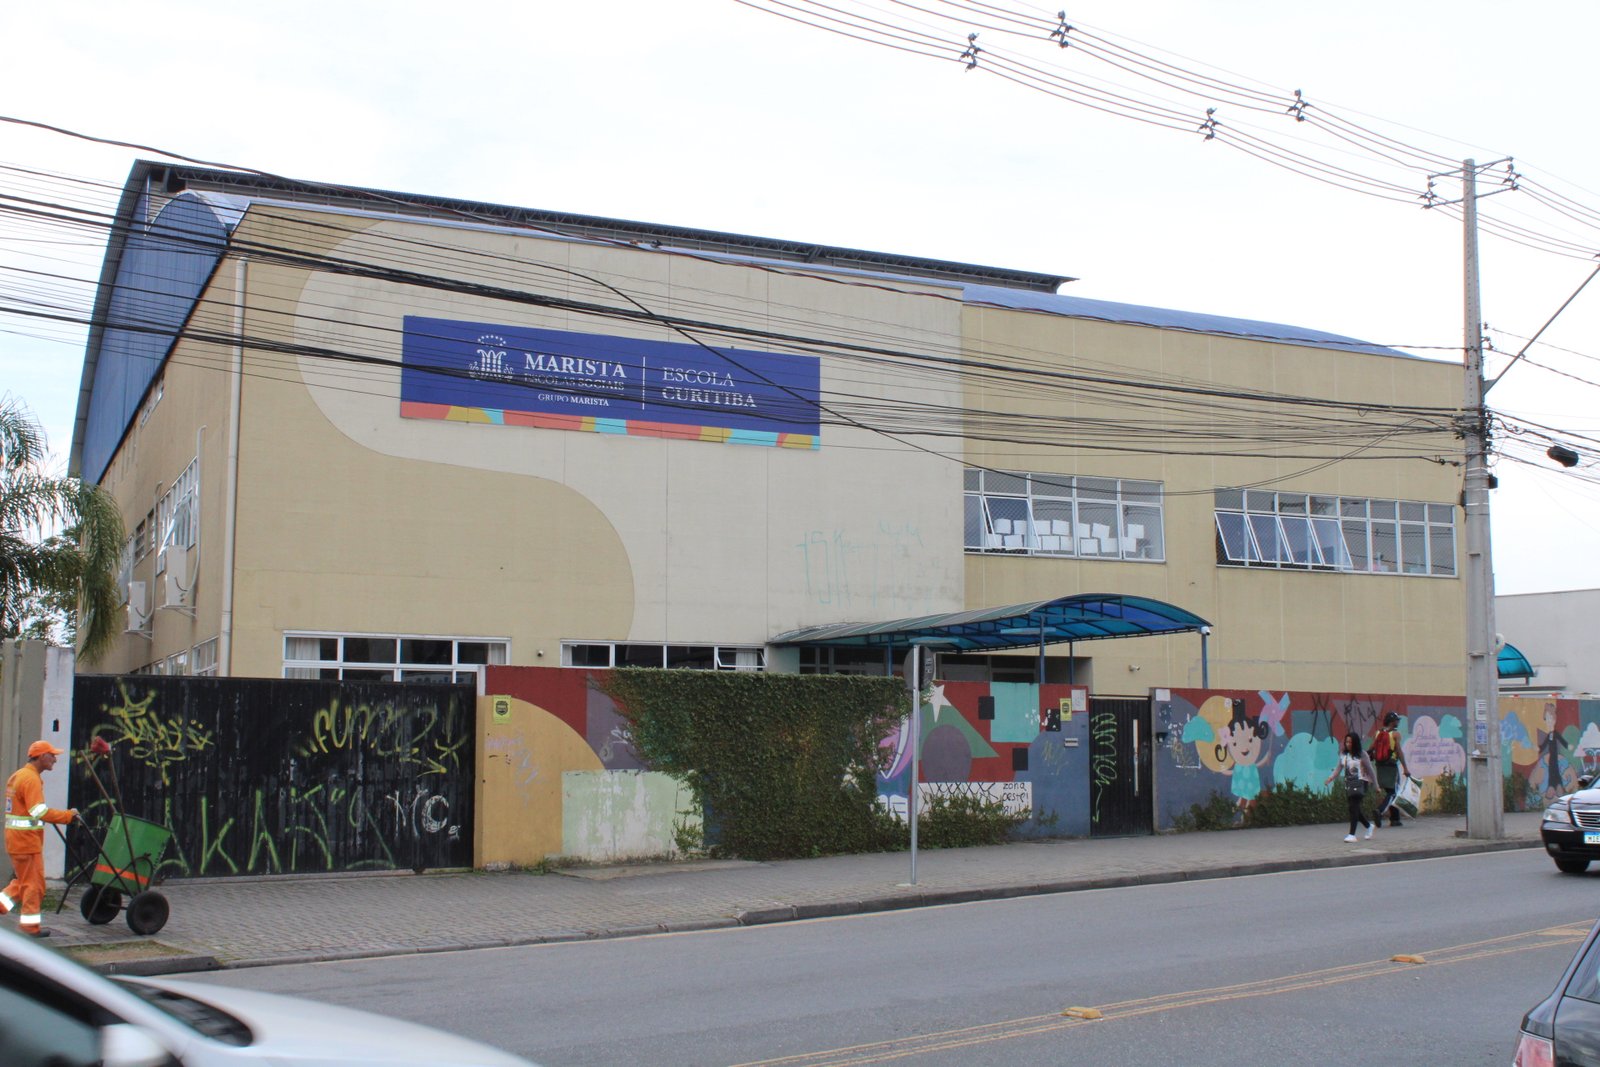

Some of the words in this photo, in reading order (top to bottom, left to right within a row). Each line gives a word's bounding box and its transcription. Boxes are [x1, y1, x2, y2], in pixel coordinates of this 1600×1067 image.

[524, 353, 627, 378] MARISTA
[662, 367, 735, 387] ESCOLA
[538, 393, 569, 403] GRUPO
[570, 395, 609, 407] MARISTA
[661, 386, 758, 408] CURITIBA
